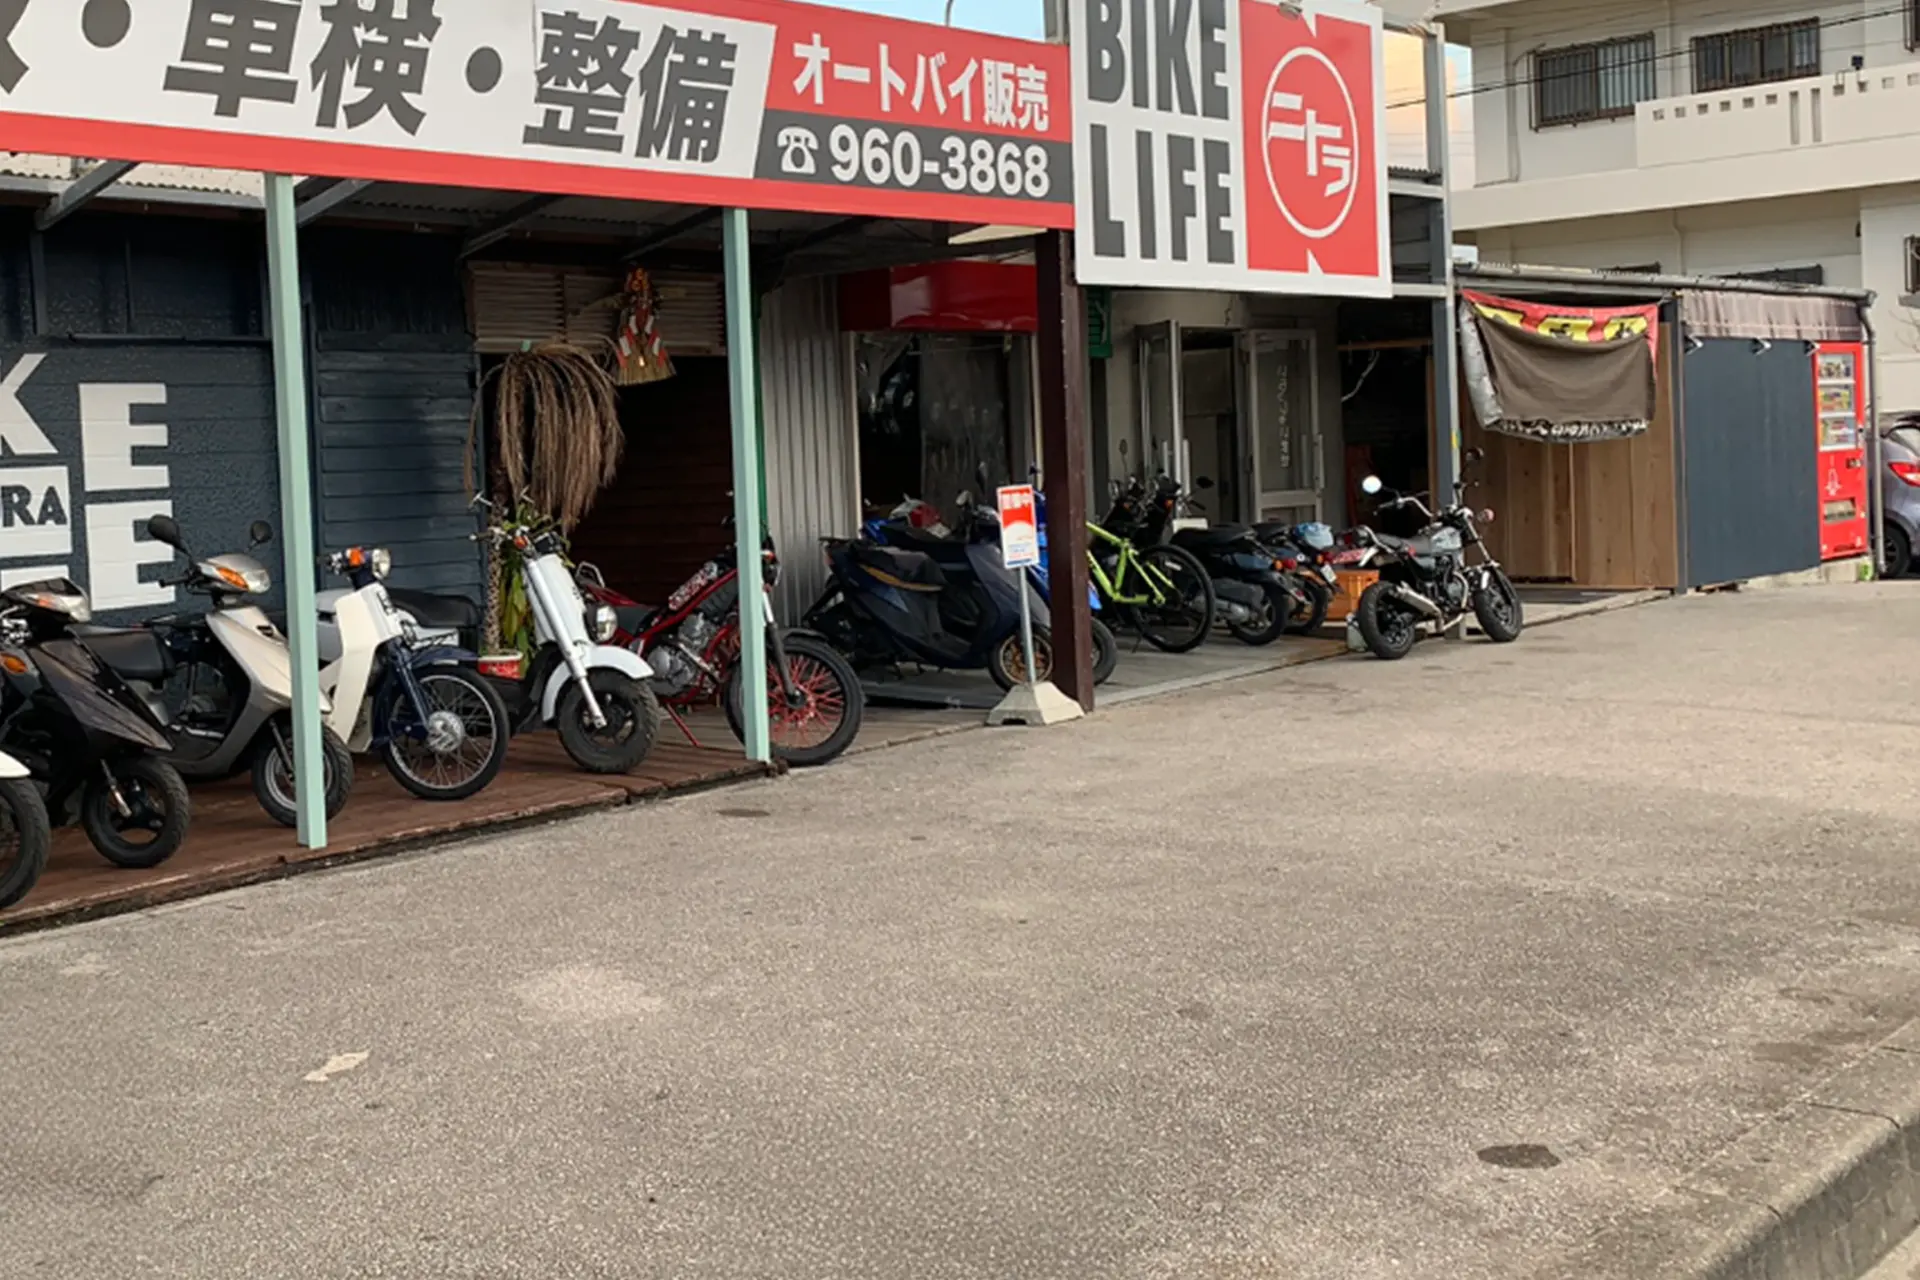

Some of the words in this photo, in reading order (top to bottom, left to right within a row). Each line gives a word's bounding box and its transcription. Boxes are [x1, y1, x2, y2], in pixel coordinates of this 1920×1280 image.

[0, 0, 738, 164] ・車検・整備
[792, 33, 1050, 133] オートバイ販売
[1086, 0, 1229, 120] BIKE
[828, 123, 1051, 198] 960-3868
[1089, 123, 1236, 264] LIFE
